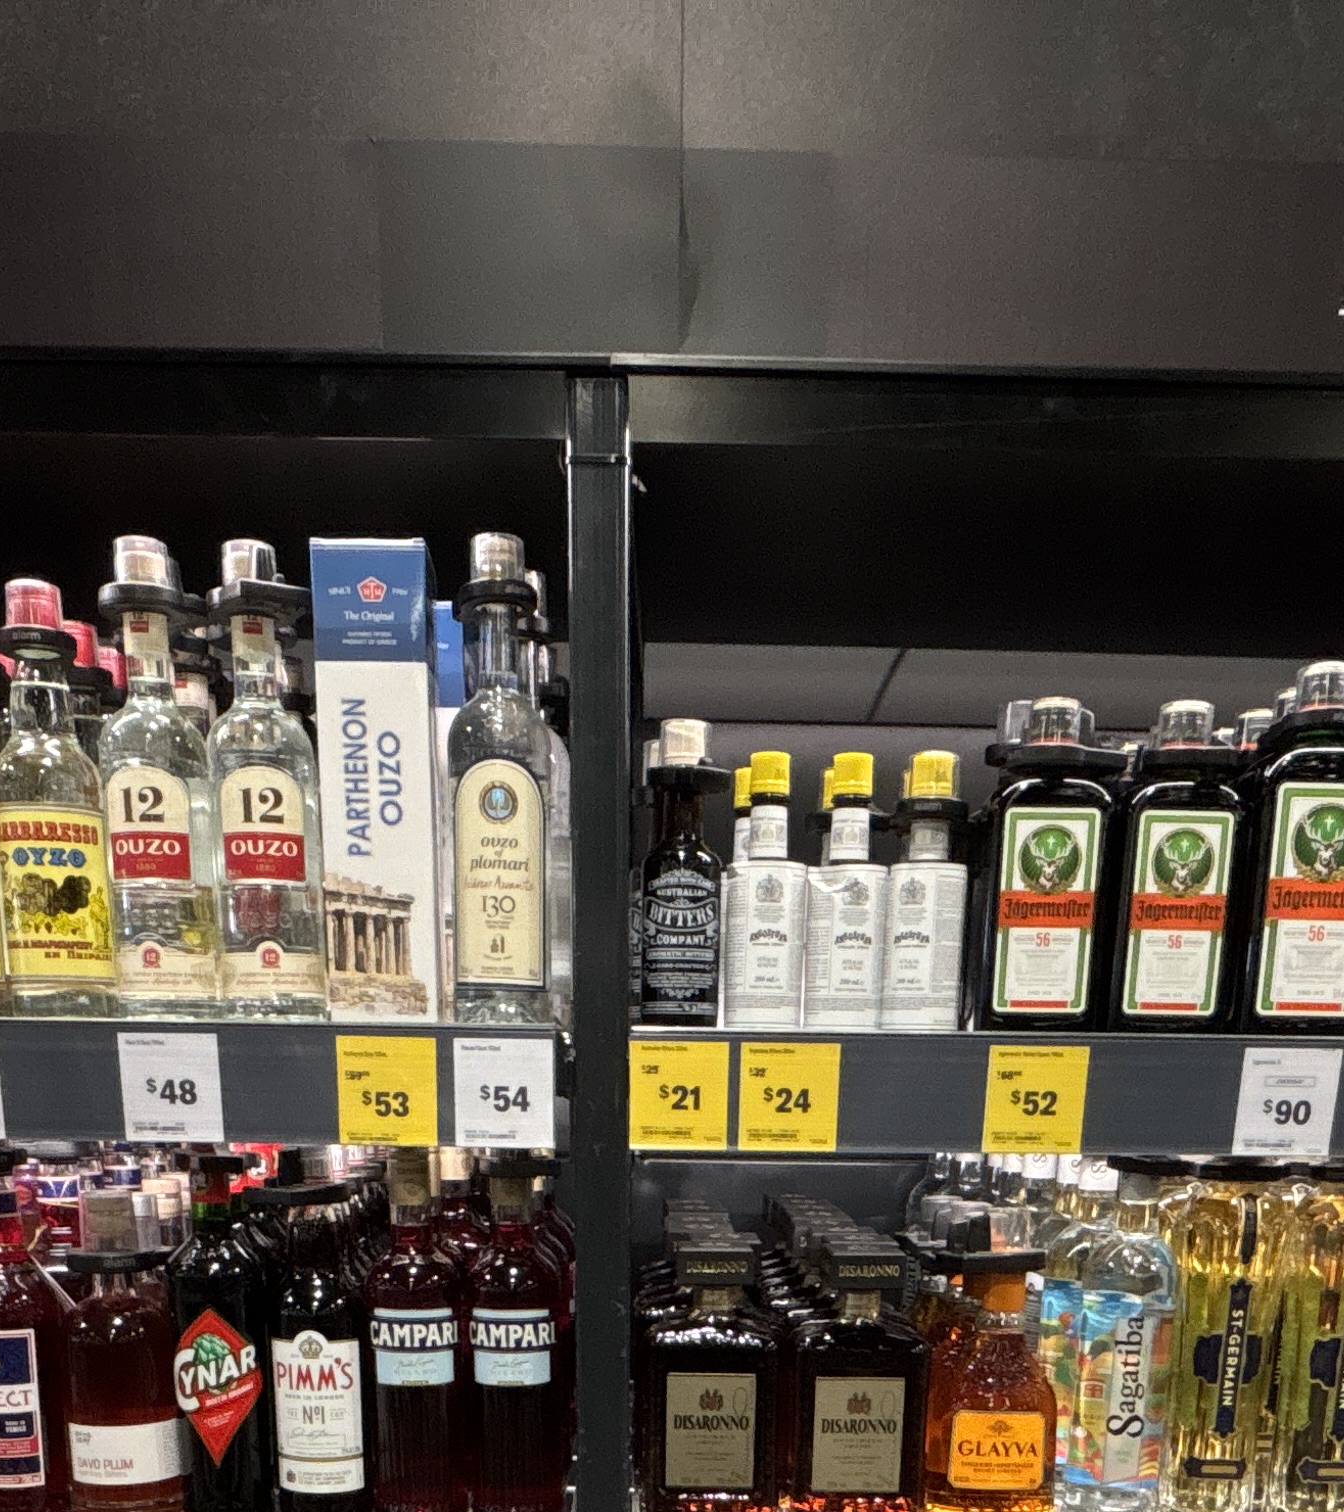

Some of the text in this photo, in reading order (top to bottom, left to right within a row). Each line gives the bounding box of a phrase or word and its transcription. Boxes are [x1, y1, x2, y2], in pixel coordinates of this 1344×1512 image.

[360, 609, 395, 624] Original
[347, 697, 371, 857] PARTHENON
[376, 730, 403, 826] OUZO
[123, 785, 165, 824] 12
[242, 786, 284, 824] 12
[115, 839, 181, 856] OUZO
[230, 839, 299, 857] OUZO
[481, 895, 516, 919] 130
[649, 902, 715, 928] BITTERS
[656, 934, 706, 947] COMPANY
[1035, 932, 1051, 947] 56
[1167, 934, 1184, 949] 56
[1308, 925, 1325, 941] 56
[146, 1078, 197, 1105] $48
[362, 1091, 409, 1117] $53
[480, 1085, 530, 1112] $54
[660, 1084, 700, 1110] $21
[764, 1088, 811, 1113] $24
[1011, 1090, 1057, 1116] $52
[1263, 1099, 1311, 1125] $90
[838, 1263, 900, 1278] DISARONNO
[370, 1319, 458, 1348] CAMPARI
[470, 1319, 555, 1348] CAMPARI
[175, 1345, 256, 1412] CYNAR
[1105, 1315, 1145, 1438] Sagatiba
[673, 1414, 750, 1432] DISARONNO
[820, 1418, 898, 1434] DISARONNO
[957, 1441, 1038, 1459] GLAYVA
